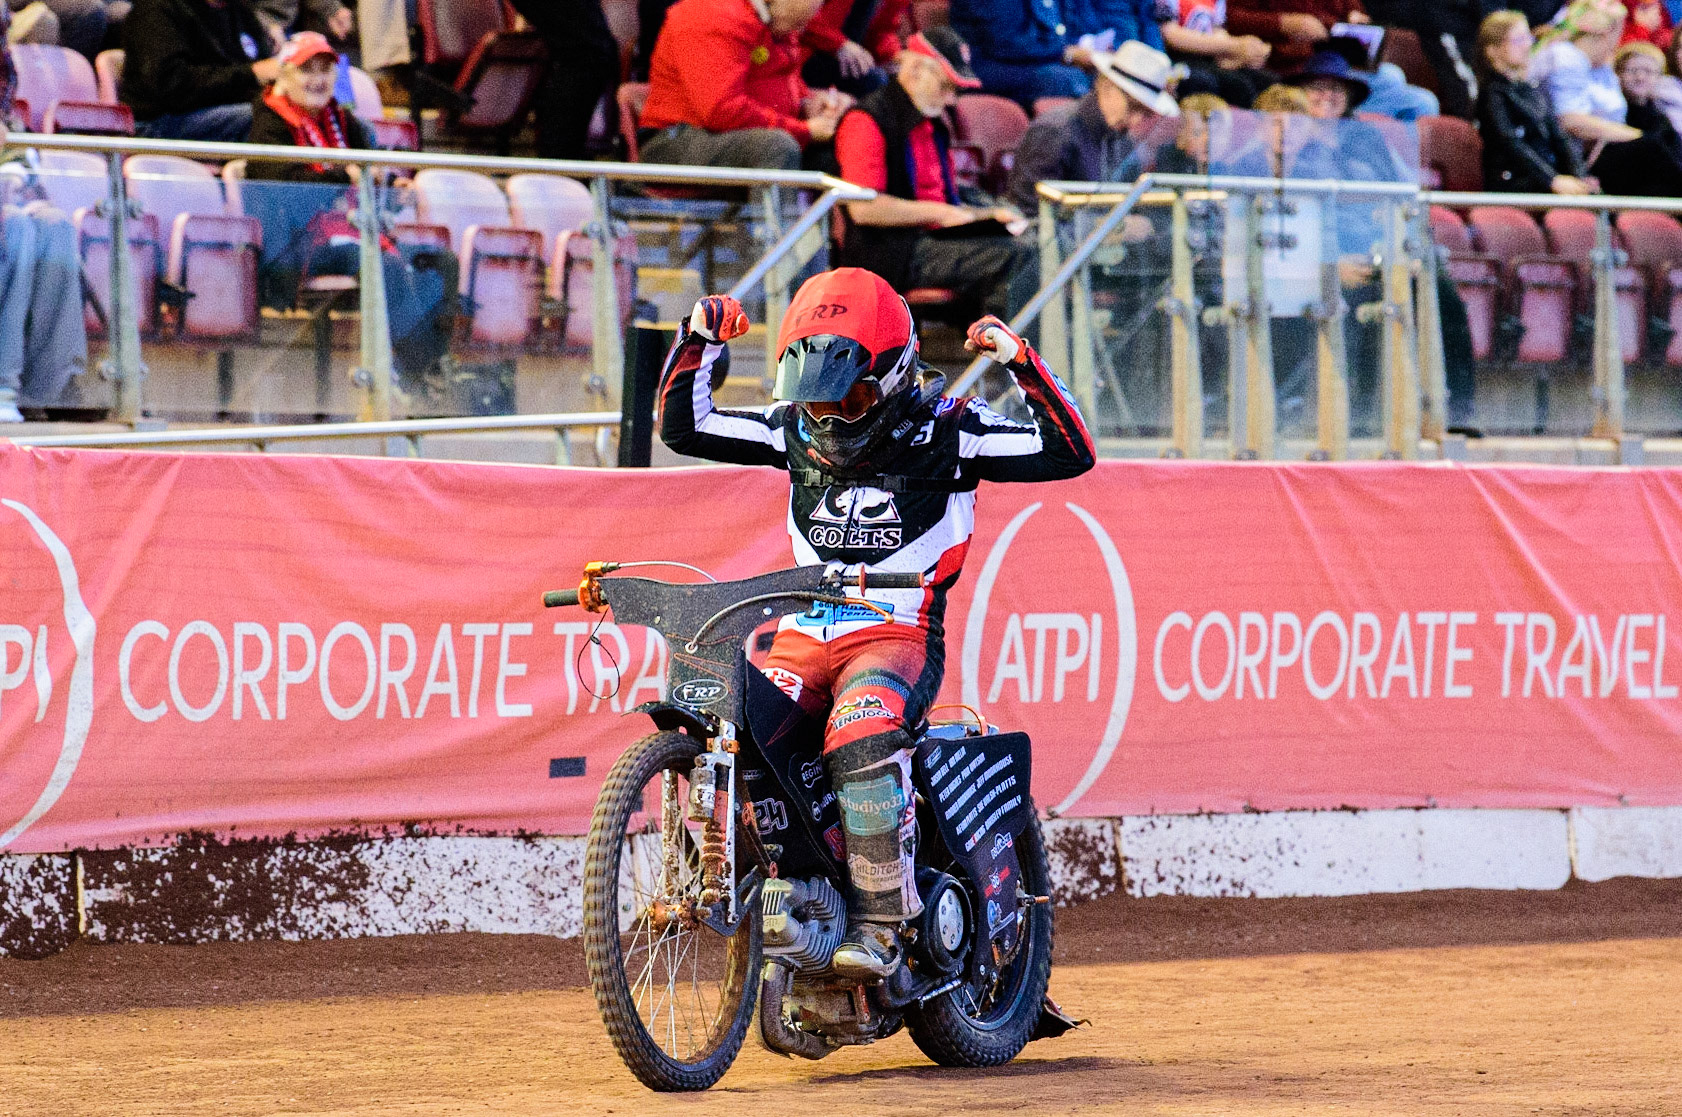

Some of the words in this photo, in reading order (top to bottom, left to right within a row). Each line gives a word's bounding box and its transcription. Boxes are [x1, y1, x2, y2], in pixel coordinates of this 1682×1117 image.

[808, 525, 902, 549] COLTS
[1153, 610, 1478, 702] CORPORATE
[1494, 611, 1680, 699] TRAVEL
[118, 620, 534, 722] CORPORATE
[553, 620, 668, 715] TRA
[682, 684, 721, 700] FRP
[801, 765, 822, 782] REGIN
[855, 861, 900, 876] HILDITCH
